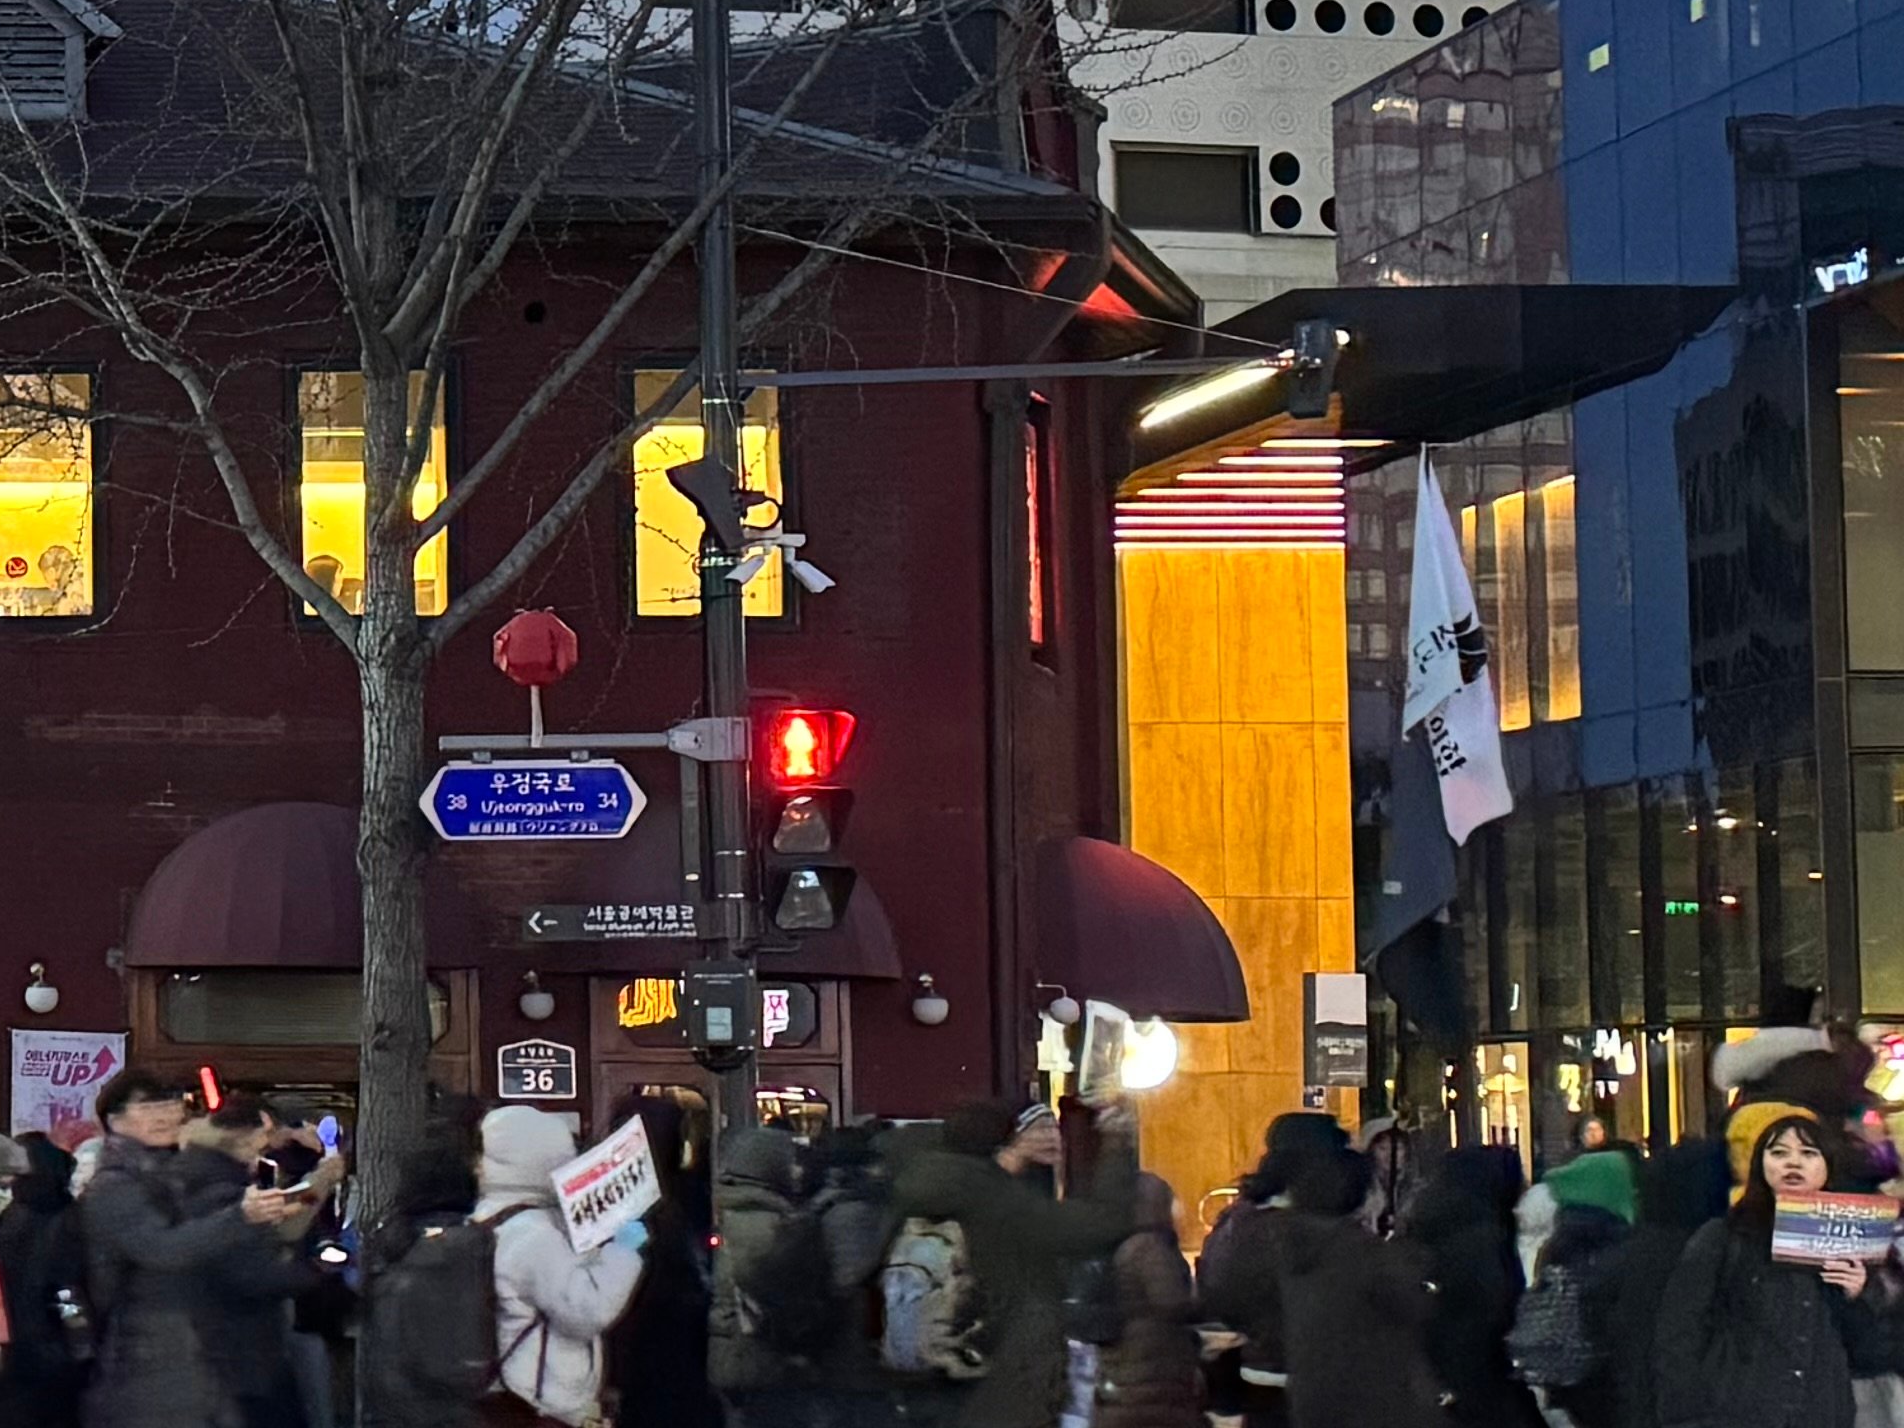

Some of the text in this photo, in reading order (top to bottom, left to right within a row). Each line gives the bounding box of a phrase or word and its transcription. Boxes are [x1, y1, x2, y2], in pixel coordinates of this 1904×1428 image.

[489, 772, 576, 795] 우정국로
[446, 794, 469, 811] 38
[597, 792, 619, 810] 34
[50, 1063, 92, 1087] UP
[521, 1068, 554, 1092] 36
